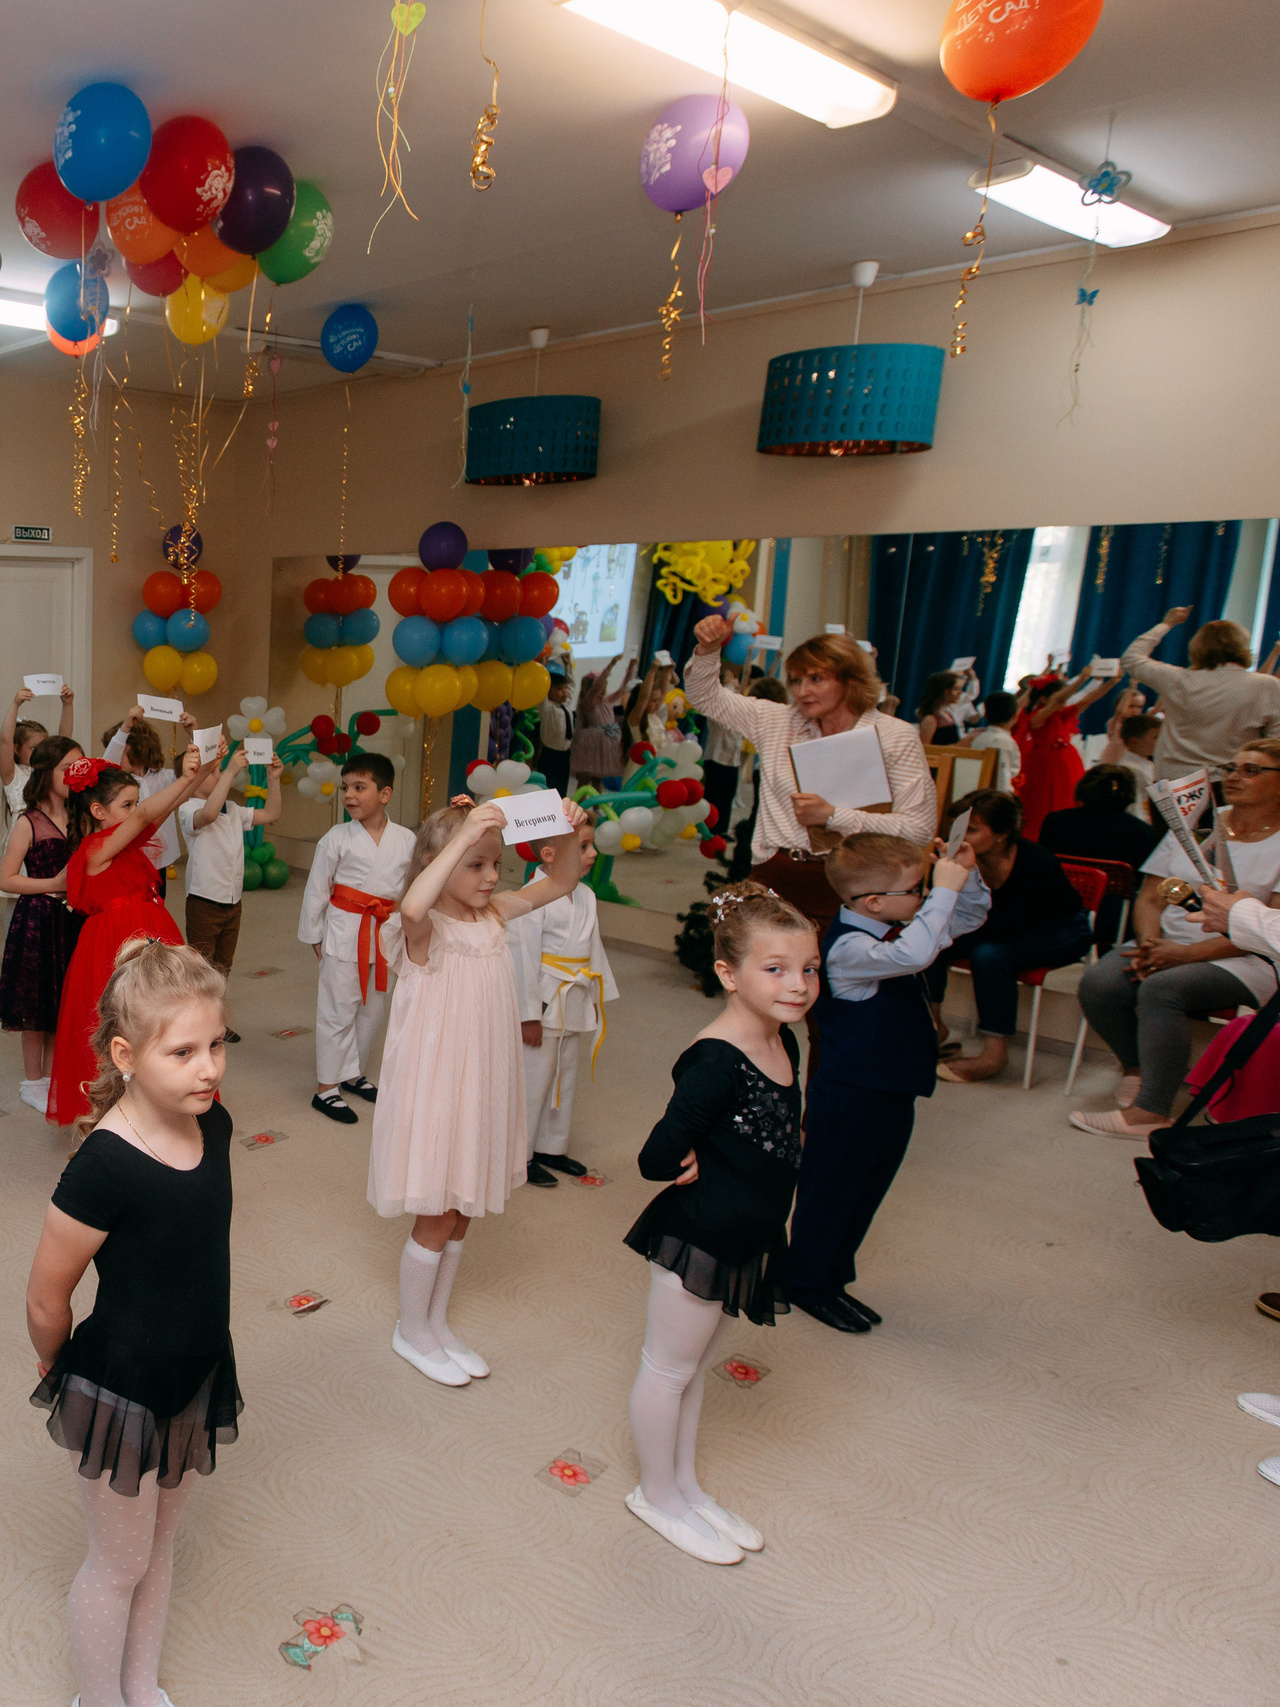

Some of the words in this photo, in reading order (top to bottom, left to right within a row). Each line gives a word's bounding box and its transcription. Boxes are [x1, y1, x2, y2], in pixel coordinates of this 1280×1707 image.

[955, 0, 999, 37] ДЕТС
[15, 528, 48, 539] ВЫХОД
[514, 813, 557, 828] Ветеринар
